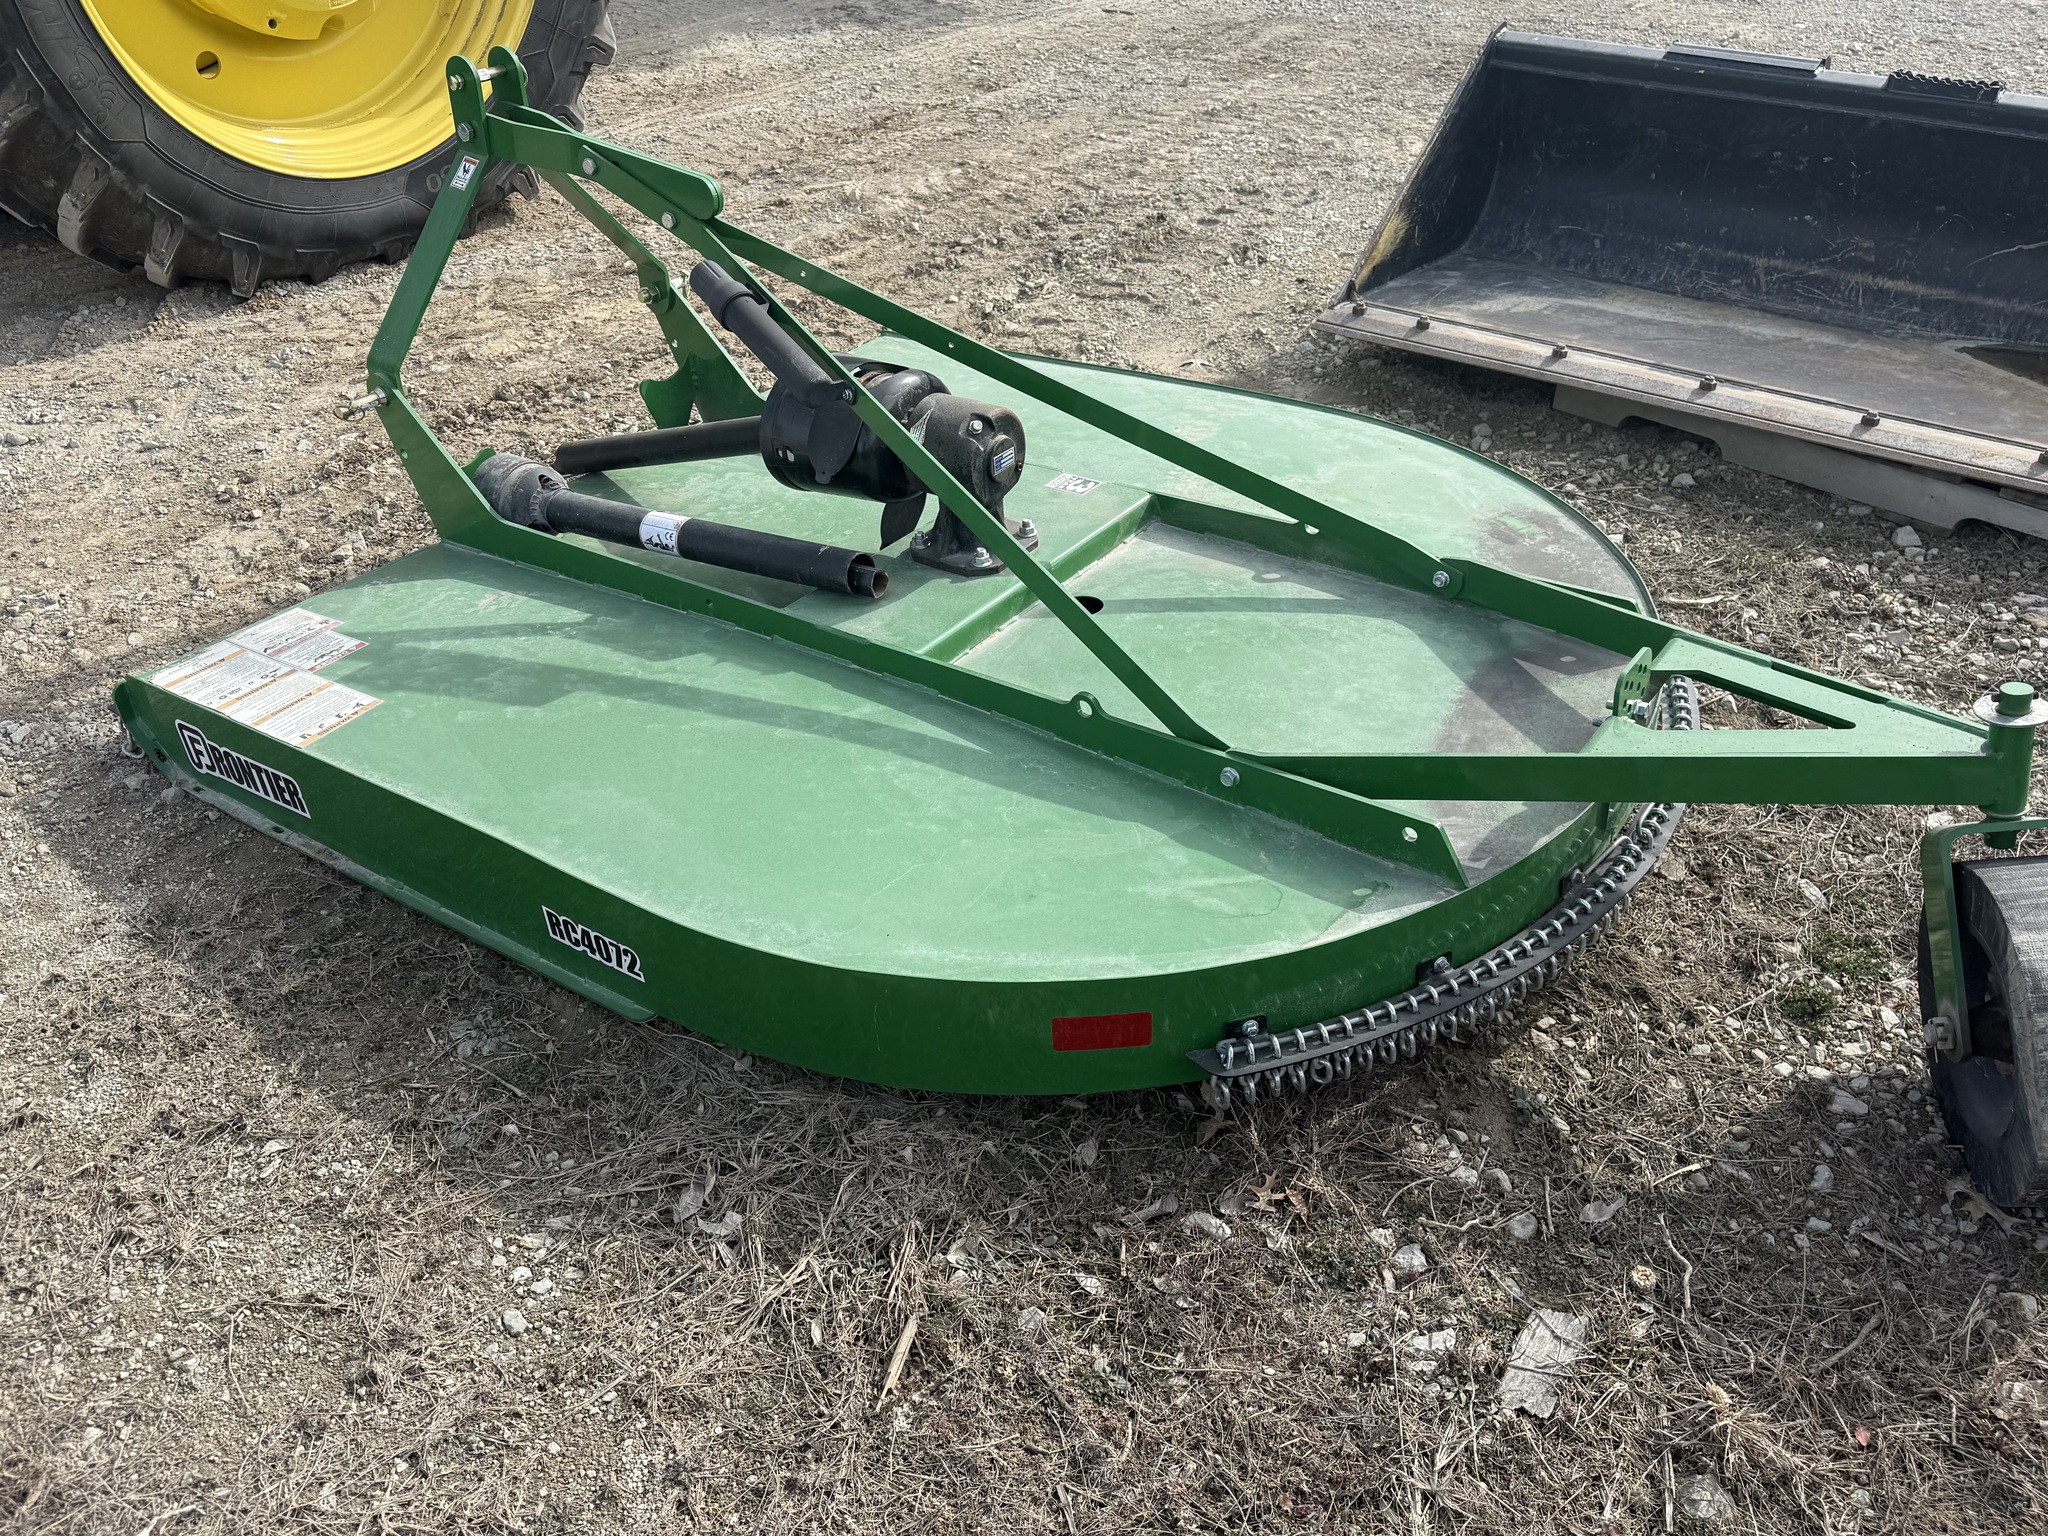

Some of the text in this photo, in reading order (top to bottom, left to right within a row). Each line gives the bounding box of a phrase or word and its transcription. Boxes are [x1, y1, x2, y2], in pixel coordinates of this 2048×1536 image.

[184, 658, 220, 679] WARNING
[315, 649, 349, 669] DANGER
[235, 681, 272, 701] WARNING
[270, 694, 307, 716] WARNING
[317, 715, 354, 737] WARNING
[176, 720, 310, 817] FRONTIER
[543, 907, 644, 981] RC4072
